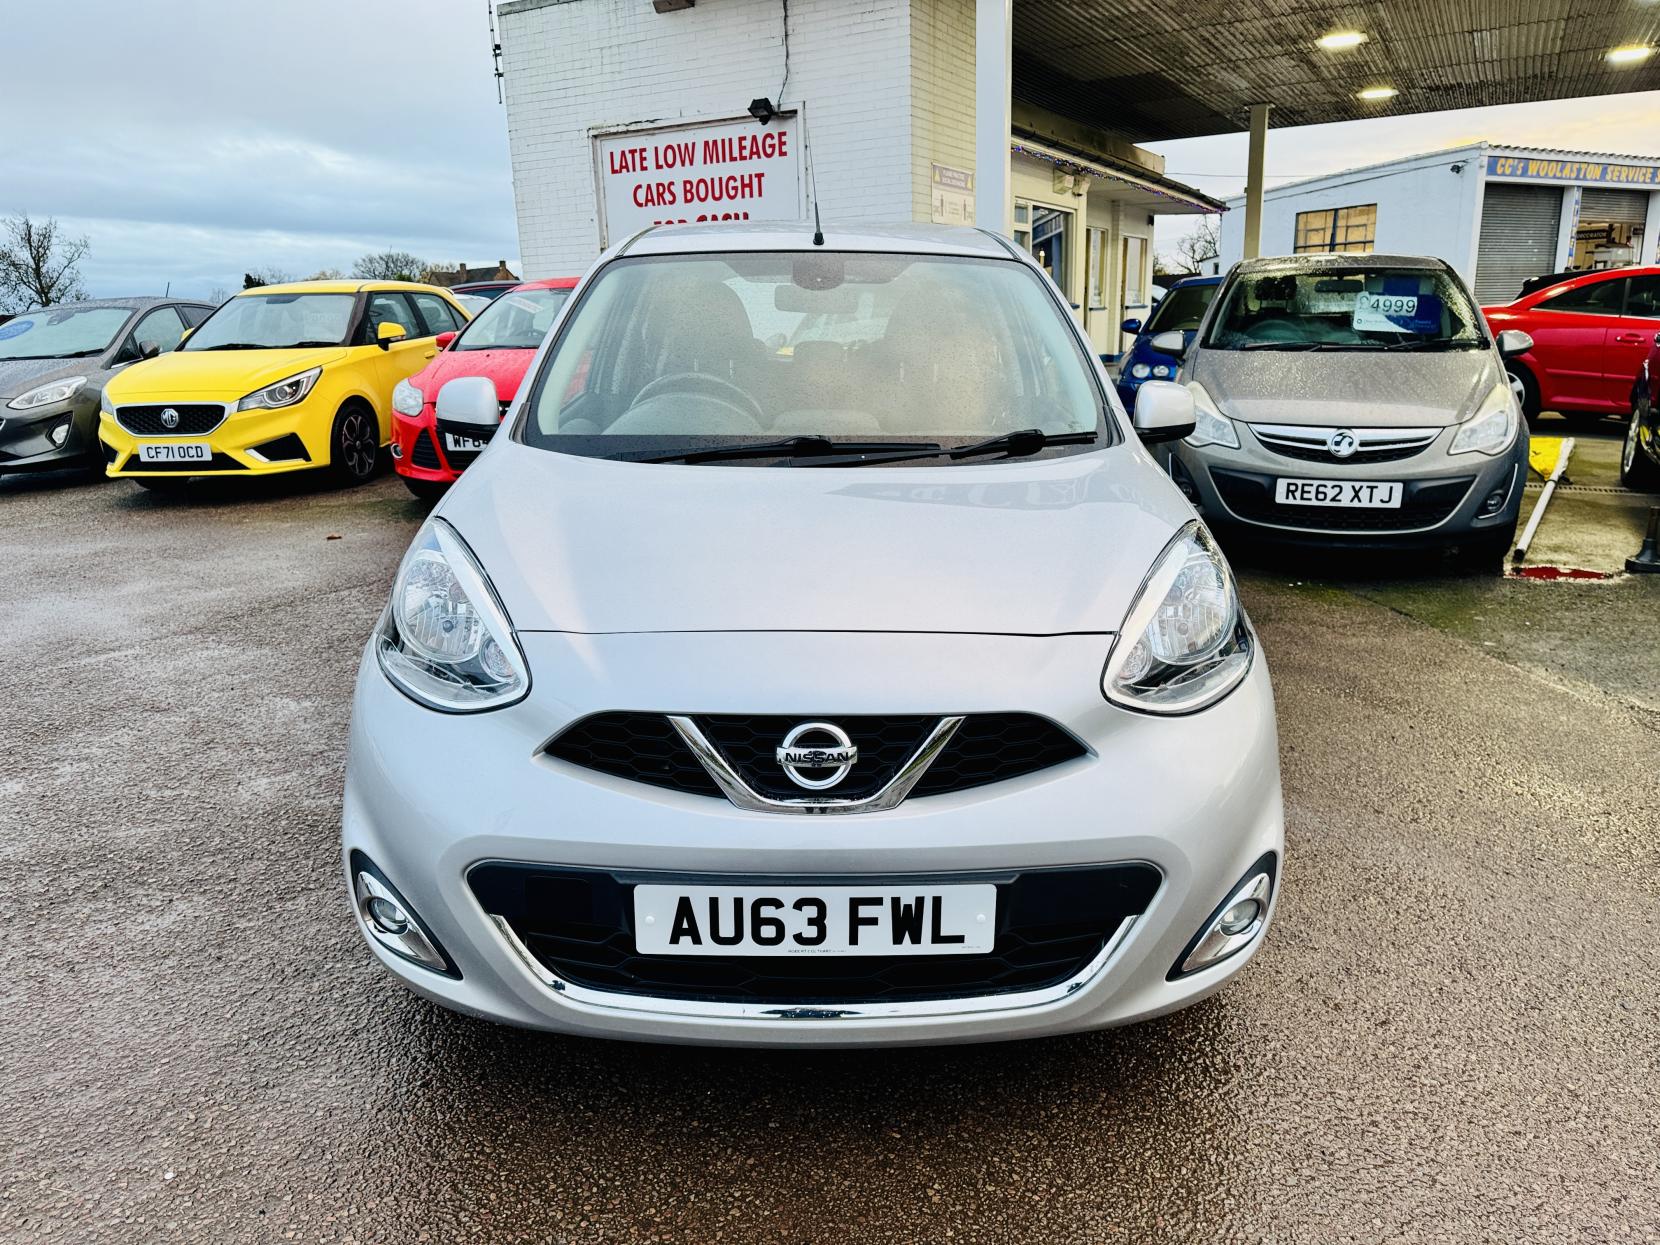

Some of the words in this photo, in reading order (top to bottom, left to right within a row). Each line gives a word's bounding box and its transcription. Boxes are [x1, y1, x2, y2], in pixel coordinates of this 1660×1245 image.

[610, 148, 648, 174] LATE
[654, 142, 696, 169] LOW
[703, 131, 787, 164] MILEAGE
[1527, 160, 1602, 180] WOOLASTON
[1605, 166, 1653, 183] SERVICE
[633, 181, 676, 207] CARS
[683, 173, 764, 204] BOUGHT
[162, 411, 177, 426] MG
[146, 446, 175, 459] CF71
[178, 446, 203, 458] OCD
[1285, 482, 1343, 502] RE62
[1350, 485, 1393, 503] XTJ
[785, 751, 849, 763] NISSAN
[669, 896, 827, 946] AU63
[849, 895, 965, 946] FWL
